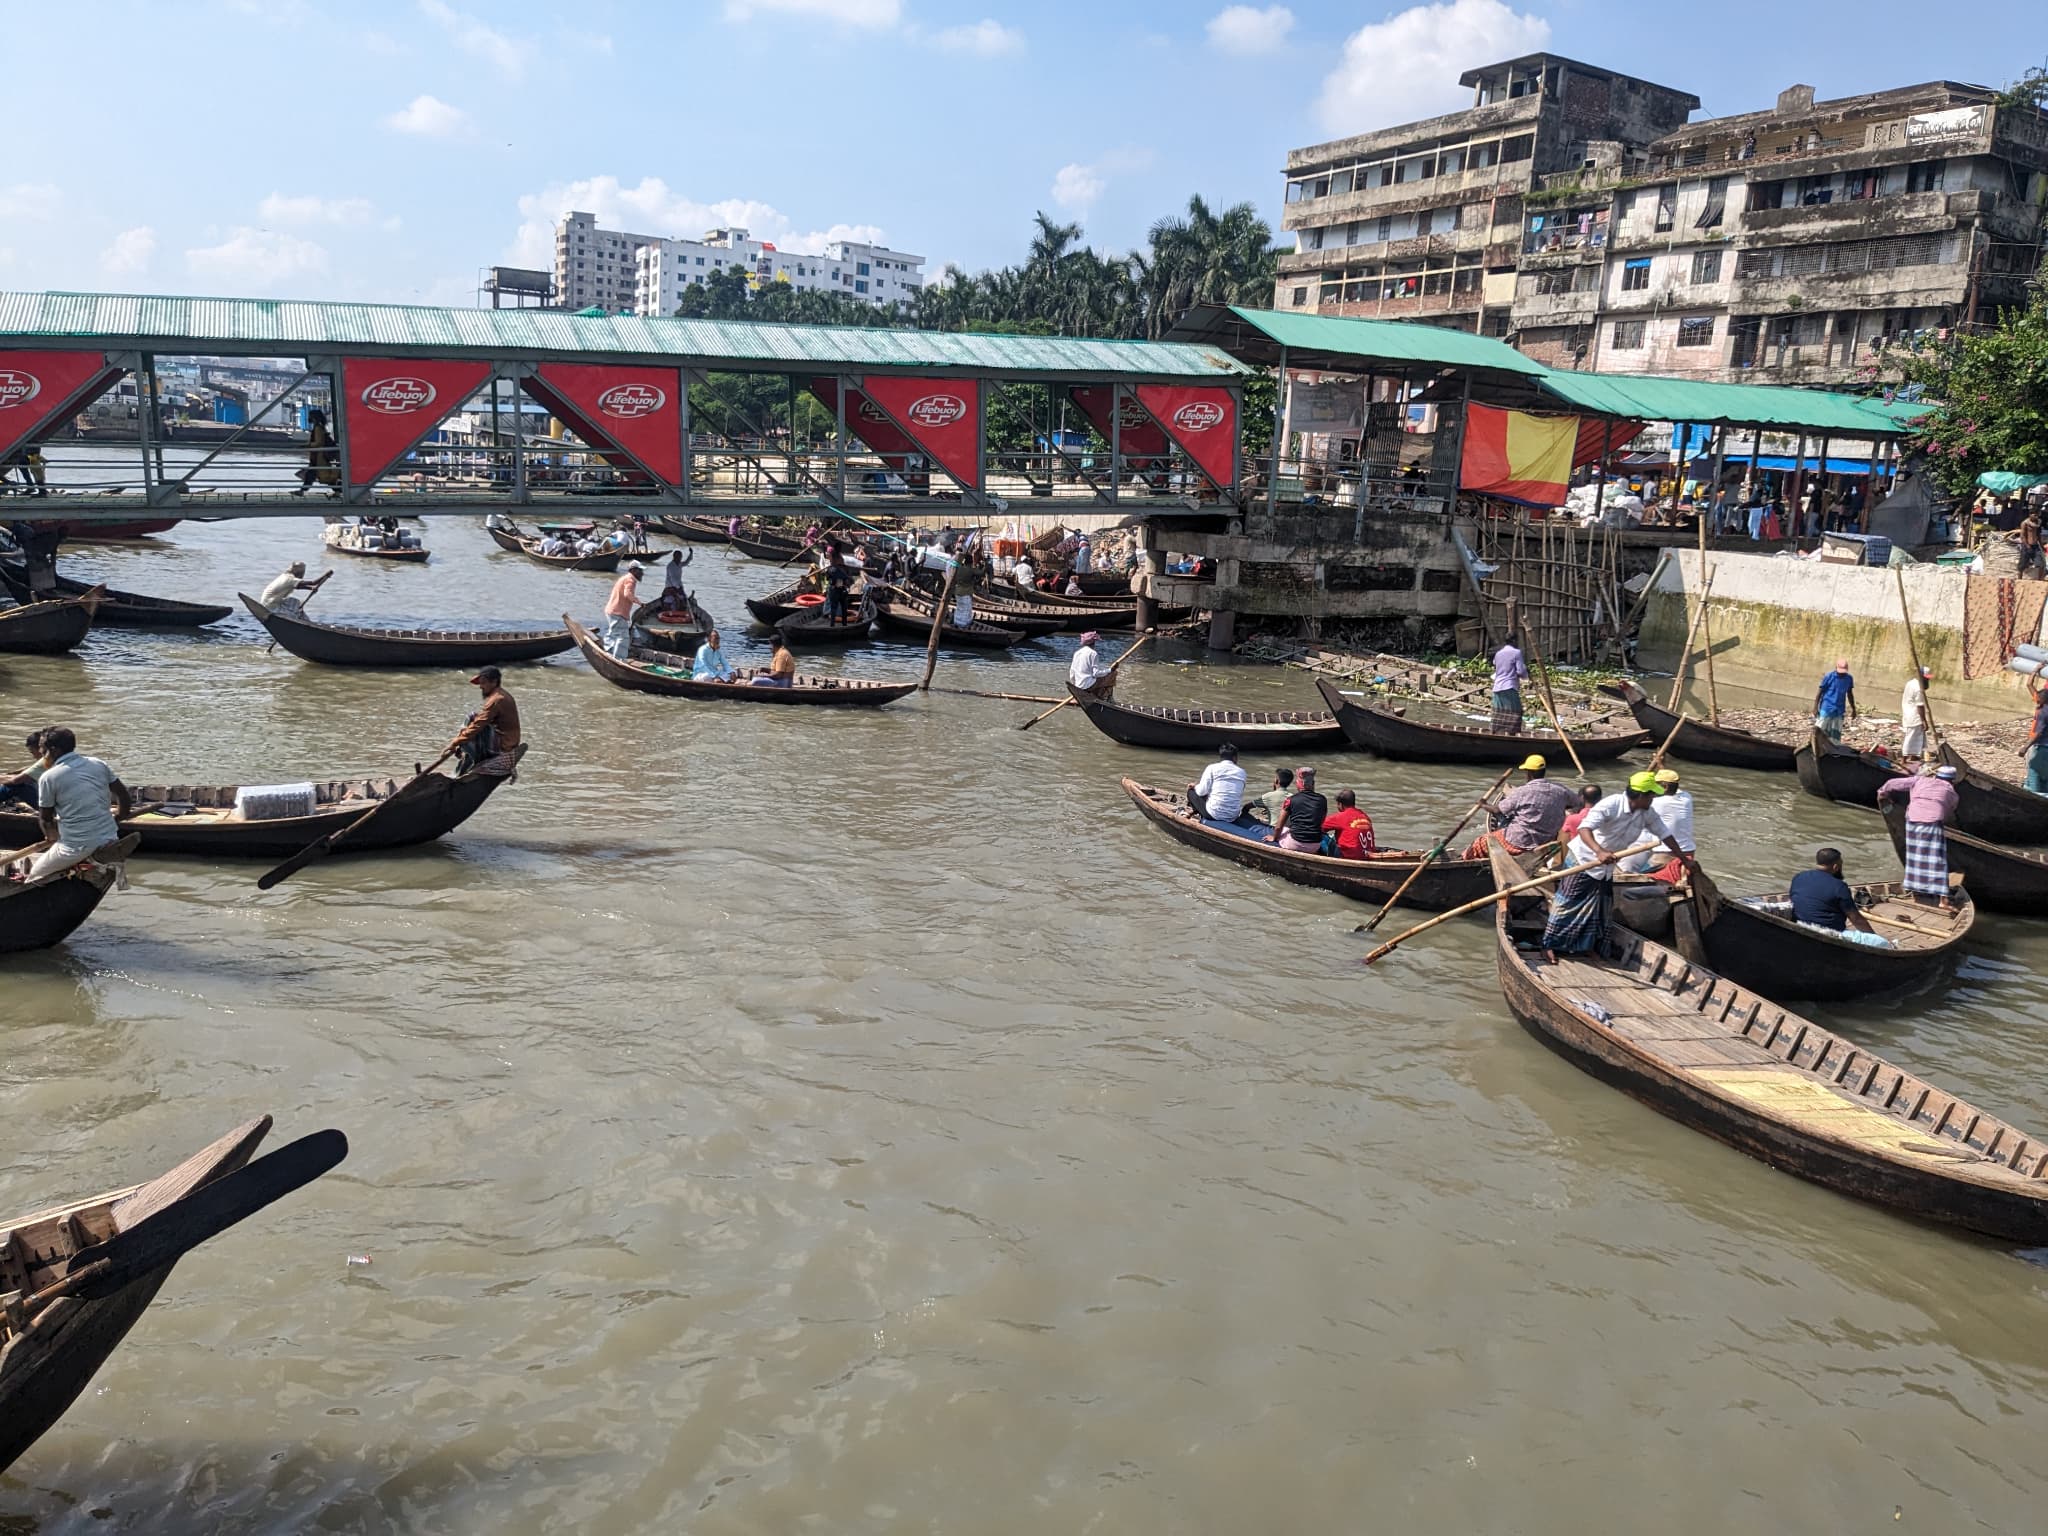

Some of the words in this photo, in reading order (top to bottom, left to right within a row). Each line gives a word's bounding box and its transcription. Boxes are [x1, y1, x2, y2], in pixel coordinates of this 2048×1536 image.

[371, 389, 427, 402] Lifebuoy
[606, 395, 657, 406] Lifebuoy
[915, 404, 959, 416] Lifebuoy
[1180, 411, 1218, 421] Lifebuoy
